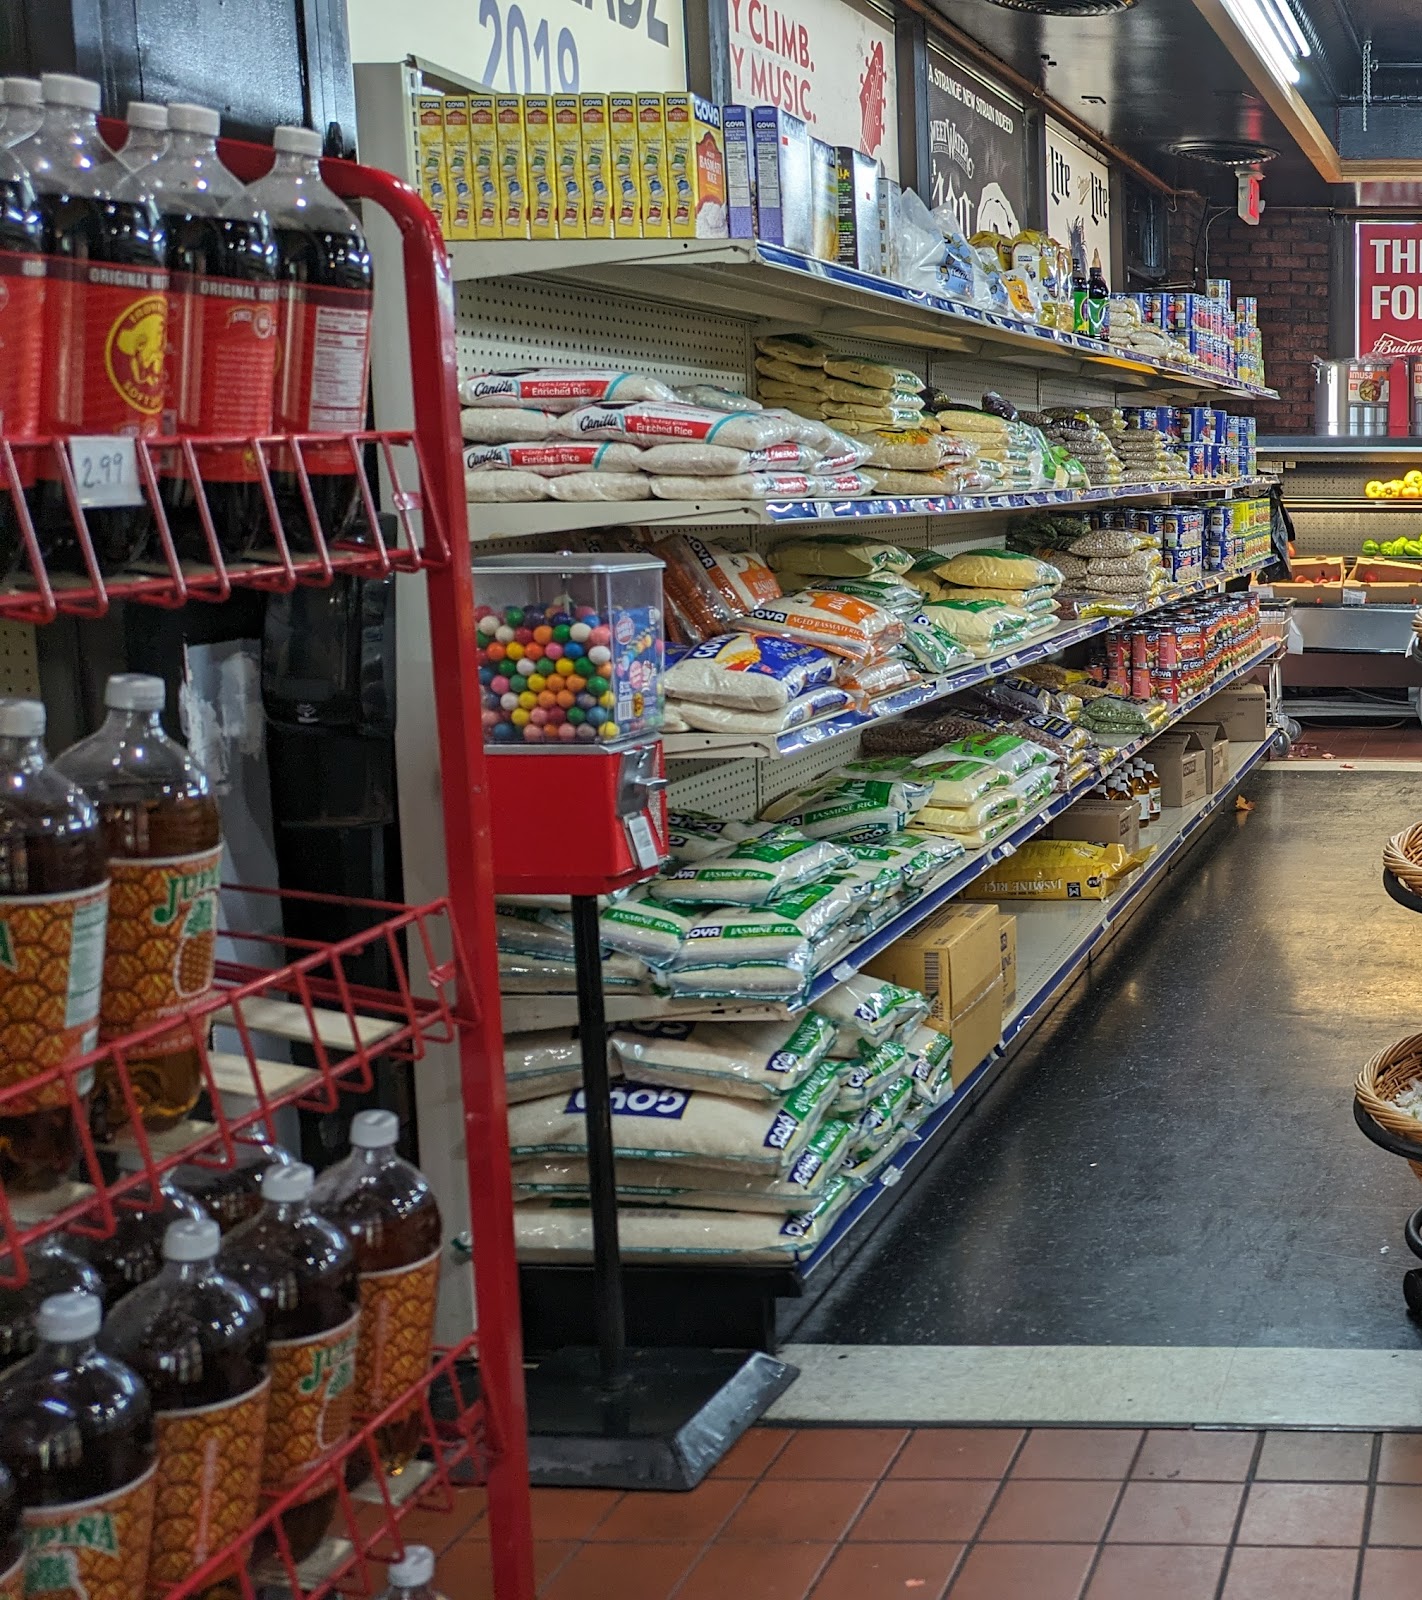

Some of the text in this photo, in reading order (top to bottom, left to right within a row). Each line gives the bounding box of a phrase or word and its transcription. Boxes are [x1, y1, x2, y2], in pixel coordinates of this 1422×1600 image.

[749, 0, 815, 72] CLIMB.
[751, 53, 817, 124] MUSIC.
[928, 64, 1014, 135] A STRANGE NEW STRAIN INDEED
[694, 100, 721, 127] GOYA
[757, 121, 776, 129] GOYA
[532, 386, 591, 396] Enriched Rice
[580, 413, 617, 432] Canilla
[674, 426, 693, 437] Rice
[561, 454, 580, 463] Rice
[812, 803, 854, 821] JASMINE
[704, 870, 742, 879] JASMINE
[730, 925, 772, 936] JASMINE
[774, 925, 797, 935] RICE
